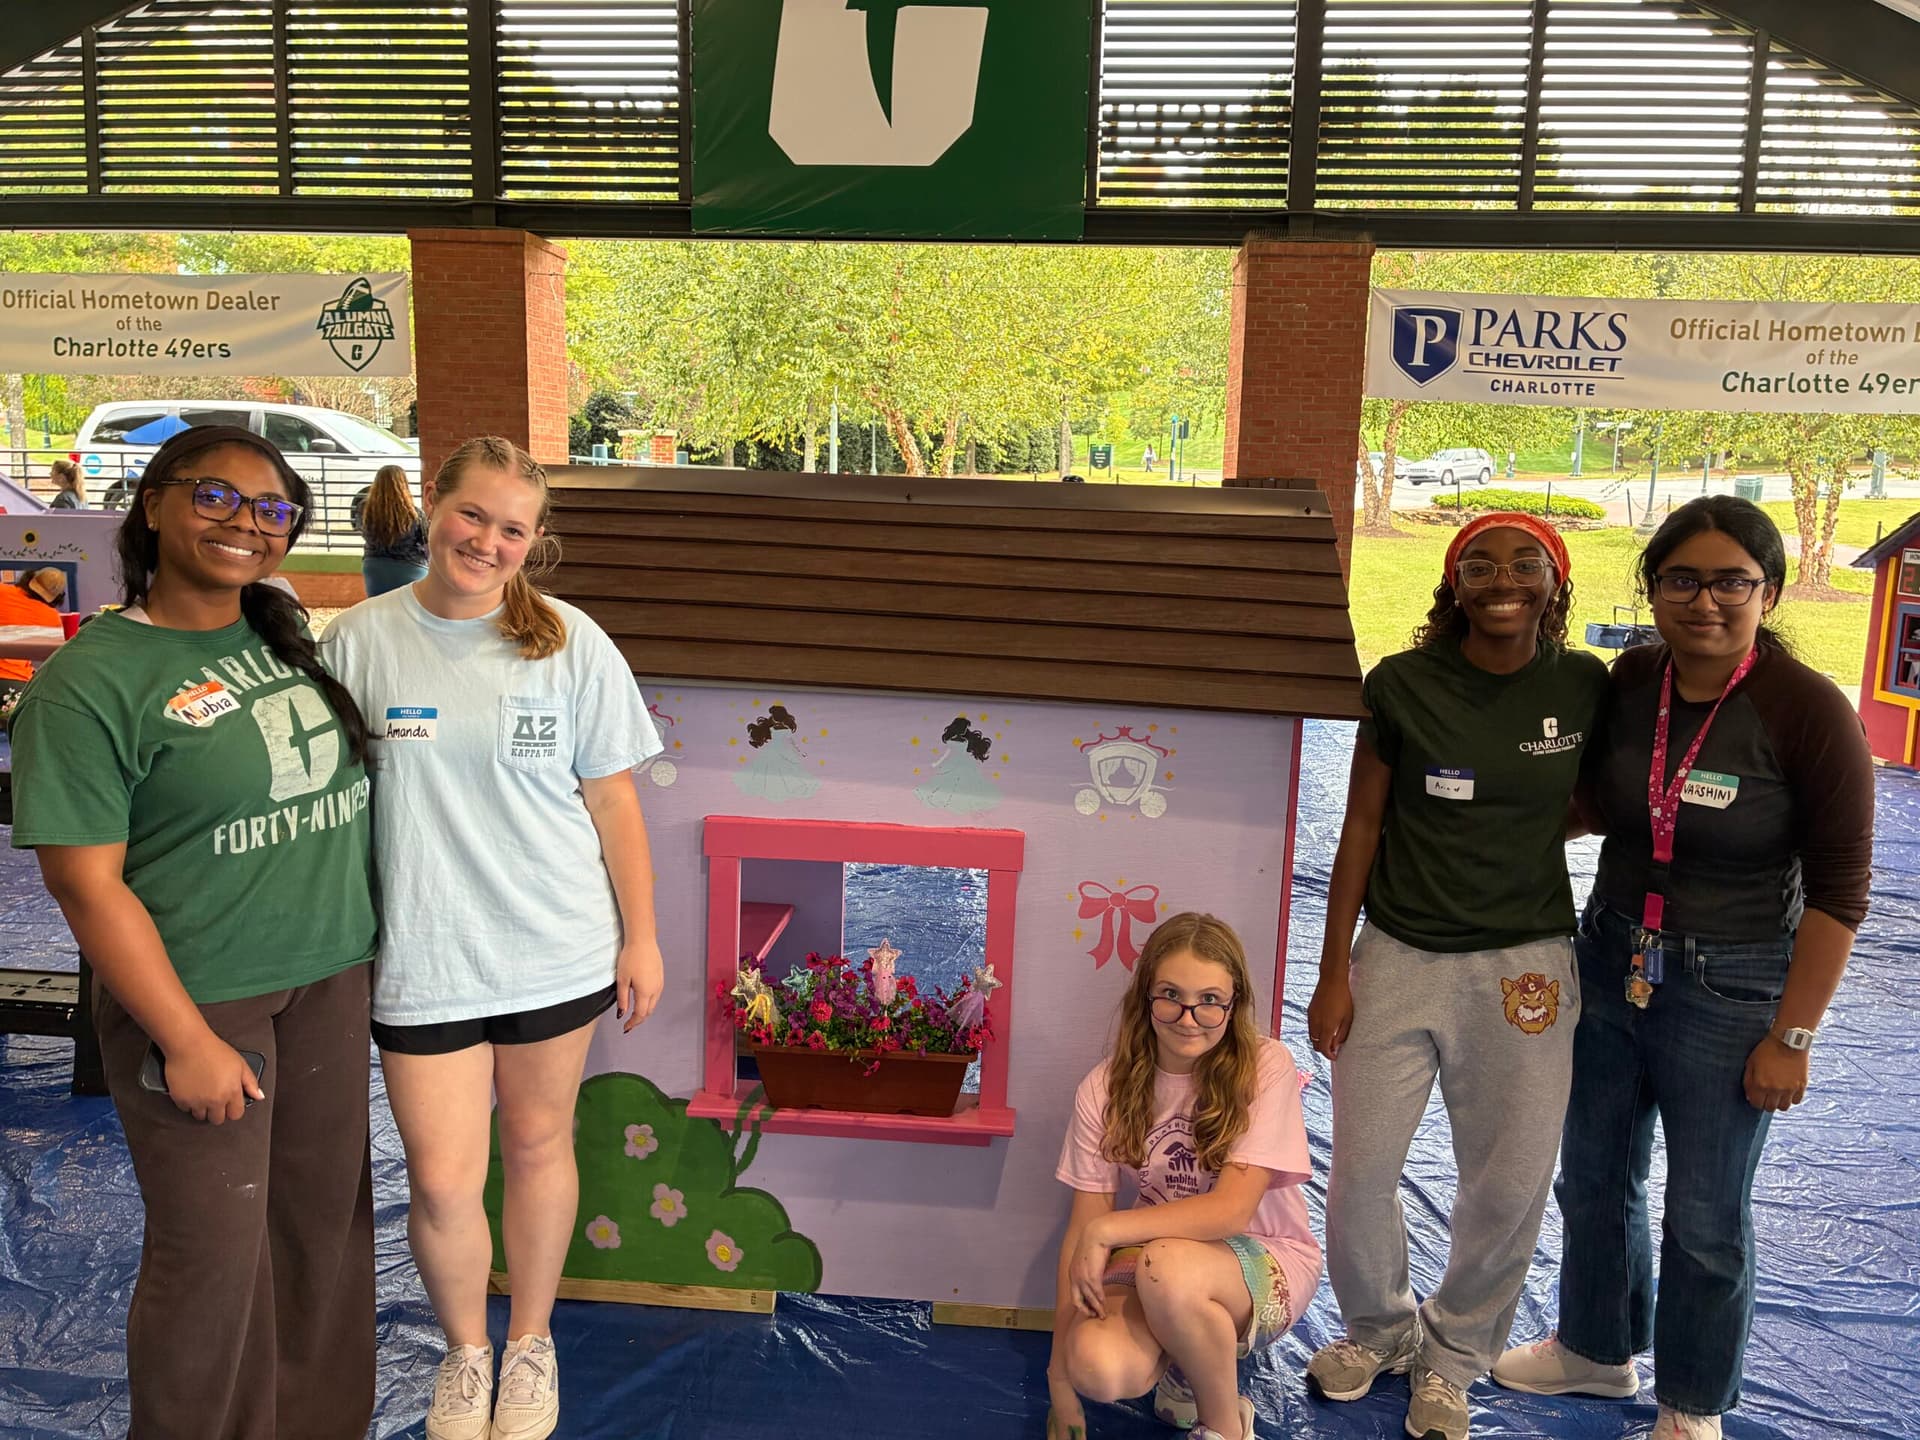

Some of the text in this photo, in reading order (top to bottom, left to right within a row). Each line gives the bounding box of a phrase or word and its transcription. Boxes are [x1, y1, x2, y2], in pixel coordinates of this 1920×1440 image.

[3, 289, 281, 311] Official Hometown Dealer
[116, 316, 162, 331] of the
[321, 310, 392, 326] ALUMNI
[324, 322, 393, 339] TAILGATE
[1468, 308, 1628, 352] PARKS
[1670, 318, 1760, 340] Official
[1768, 320, 1906, 343] Hometown
[53, 337, 231, 358] Charlotte 49ers
[1408, 314, 1447, 367] P
[352, 345, 363, 360] C
[1468, 352, 1623, 372] CHEVROLET
[1806, 349, 1858, 365] of the
[1490, 379, 1596, 396] CHARLOTTE
[1721, 371, 1849, 393] Charlotte
[182, 698, 232, 725] Nubia
[386, 722, 430, 738] Amanda
[1543, 717, 1558, 738] C
[251, 684, 340, 803] C
[1519, 731, 1583, 752] CHARLOTTE
[1701, 772, 1723, 781] HELLO
[1683, 783, 1731, 801] VARSHINI
[213, 775, 370, 855] FORTY-NINRS
[1165, 1173, 1198, 1187] Habitat
